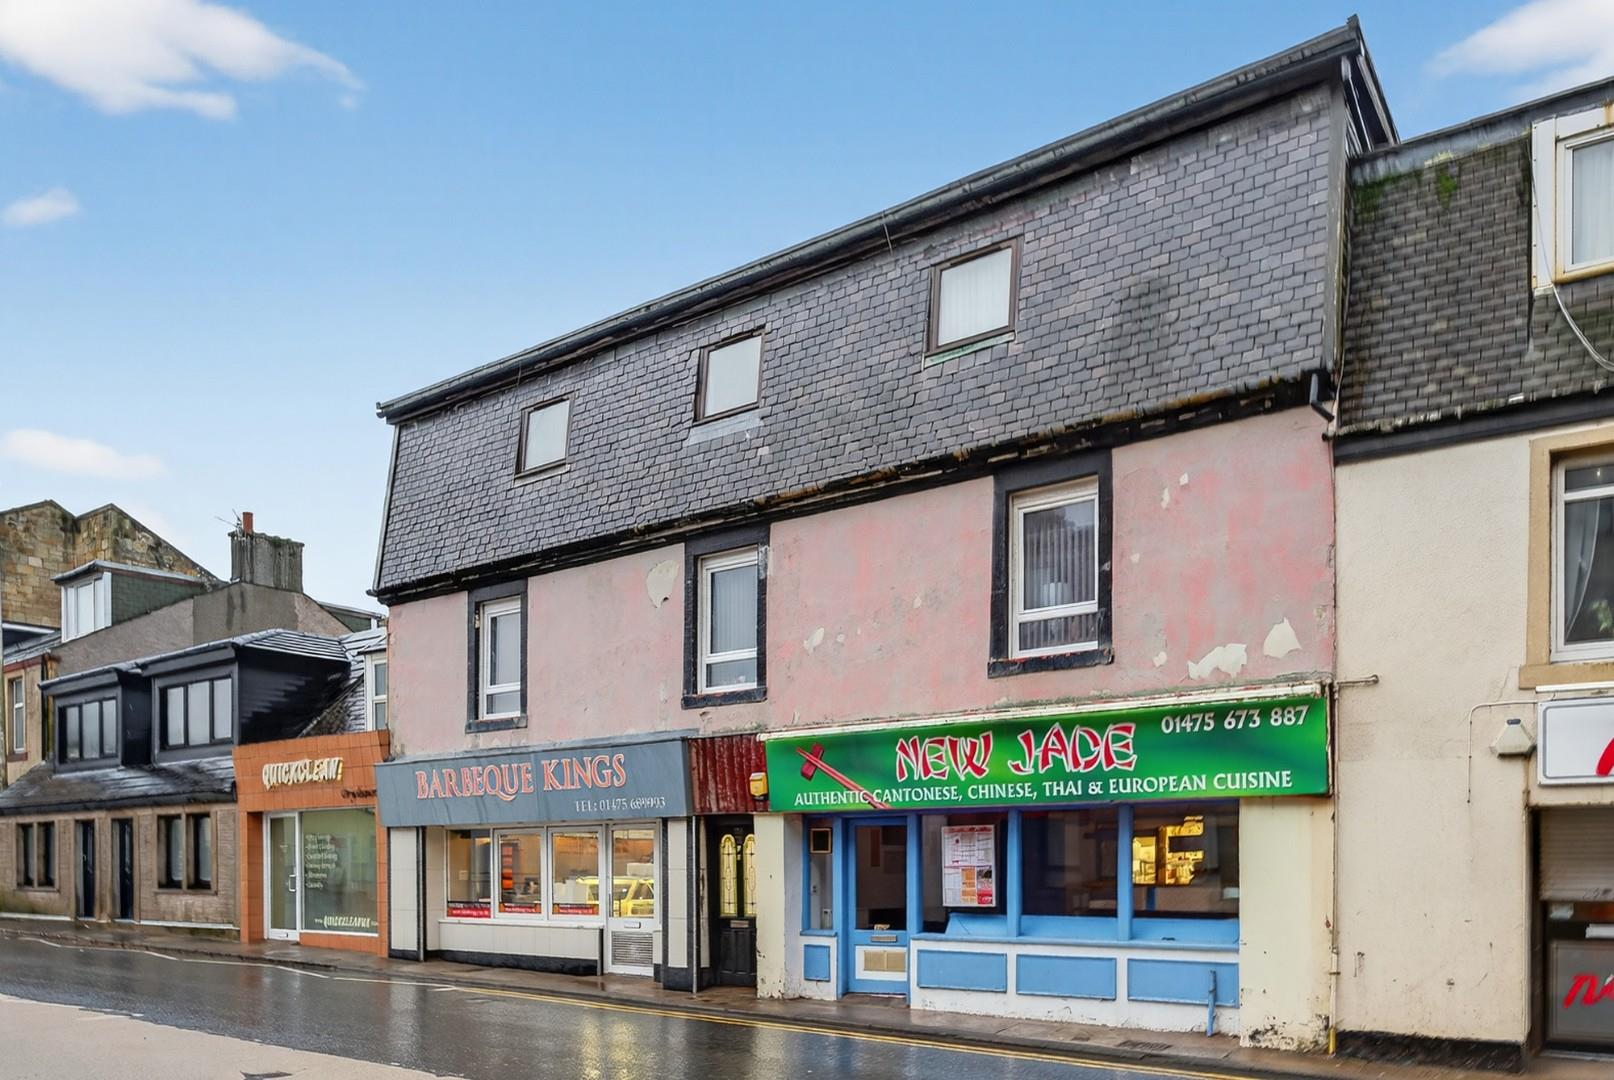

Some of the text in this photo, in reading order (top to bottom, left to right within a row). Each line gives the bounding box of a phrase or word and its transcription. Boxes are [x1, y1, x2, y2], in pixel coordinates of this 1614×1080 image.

[1161, 706, 1308, 734] 01475 673 887
[895, 723, 1137, 782] NEW JADE
[415, 762, 535, 801] BARBEQUE
[541, 753, 627, 791] KINGS
[794, 770, 1292, 807] AUTHENTIC CANTONESE, CHINESE, THAI & EUROPEAN CUISINE
